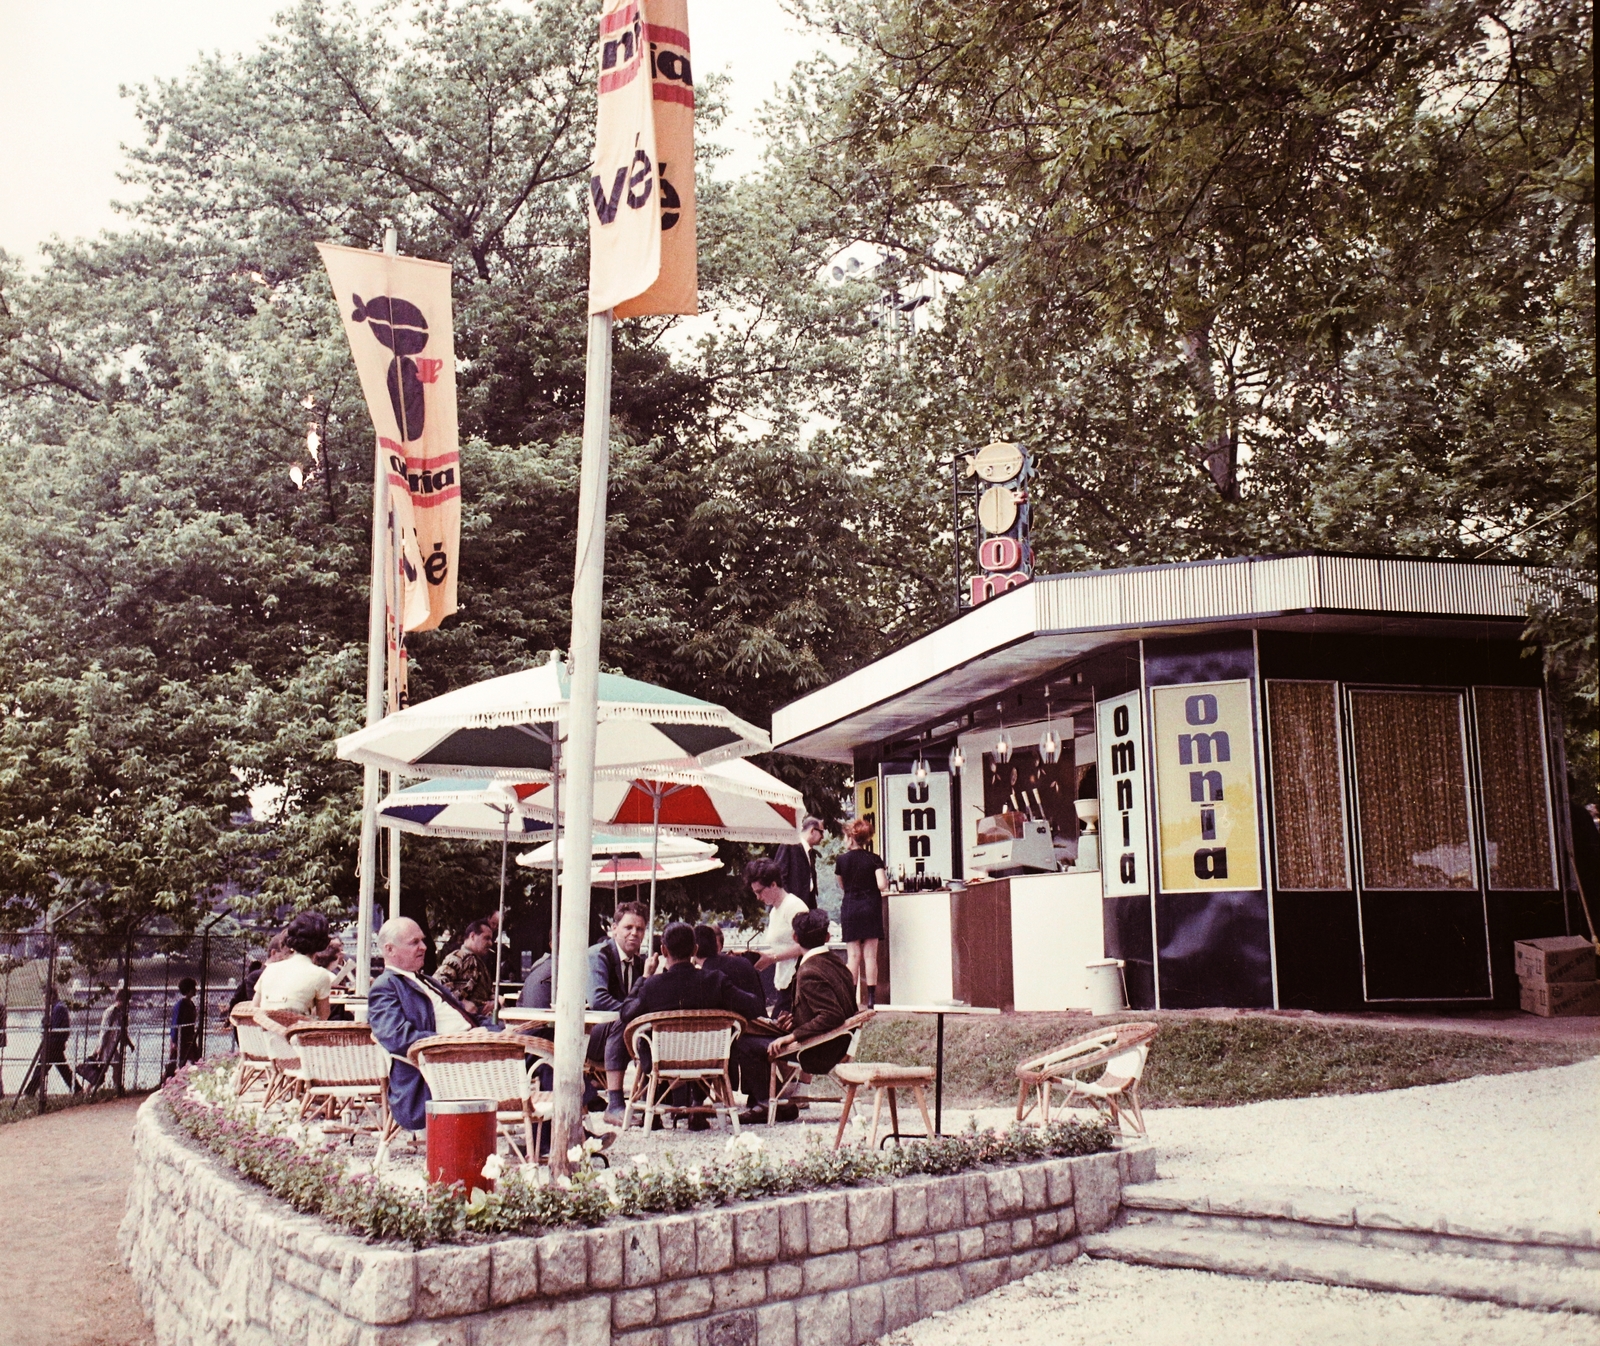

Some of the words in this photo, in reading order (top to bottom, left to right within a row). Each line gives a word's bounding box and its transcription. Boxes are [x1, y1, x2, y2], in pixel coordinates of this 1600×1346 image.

[591, 132, 652, 226] vé
[1111, 705, 1136, 884] omnia
[1178, 694, 1231, 880] omnia
